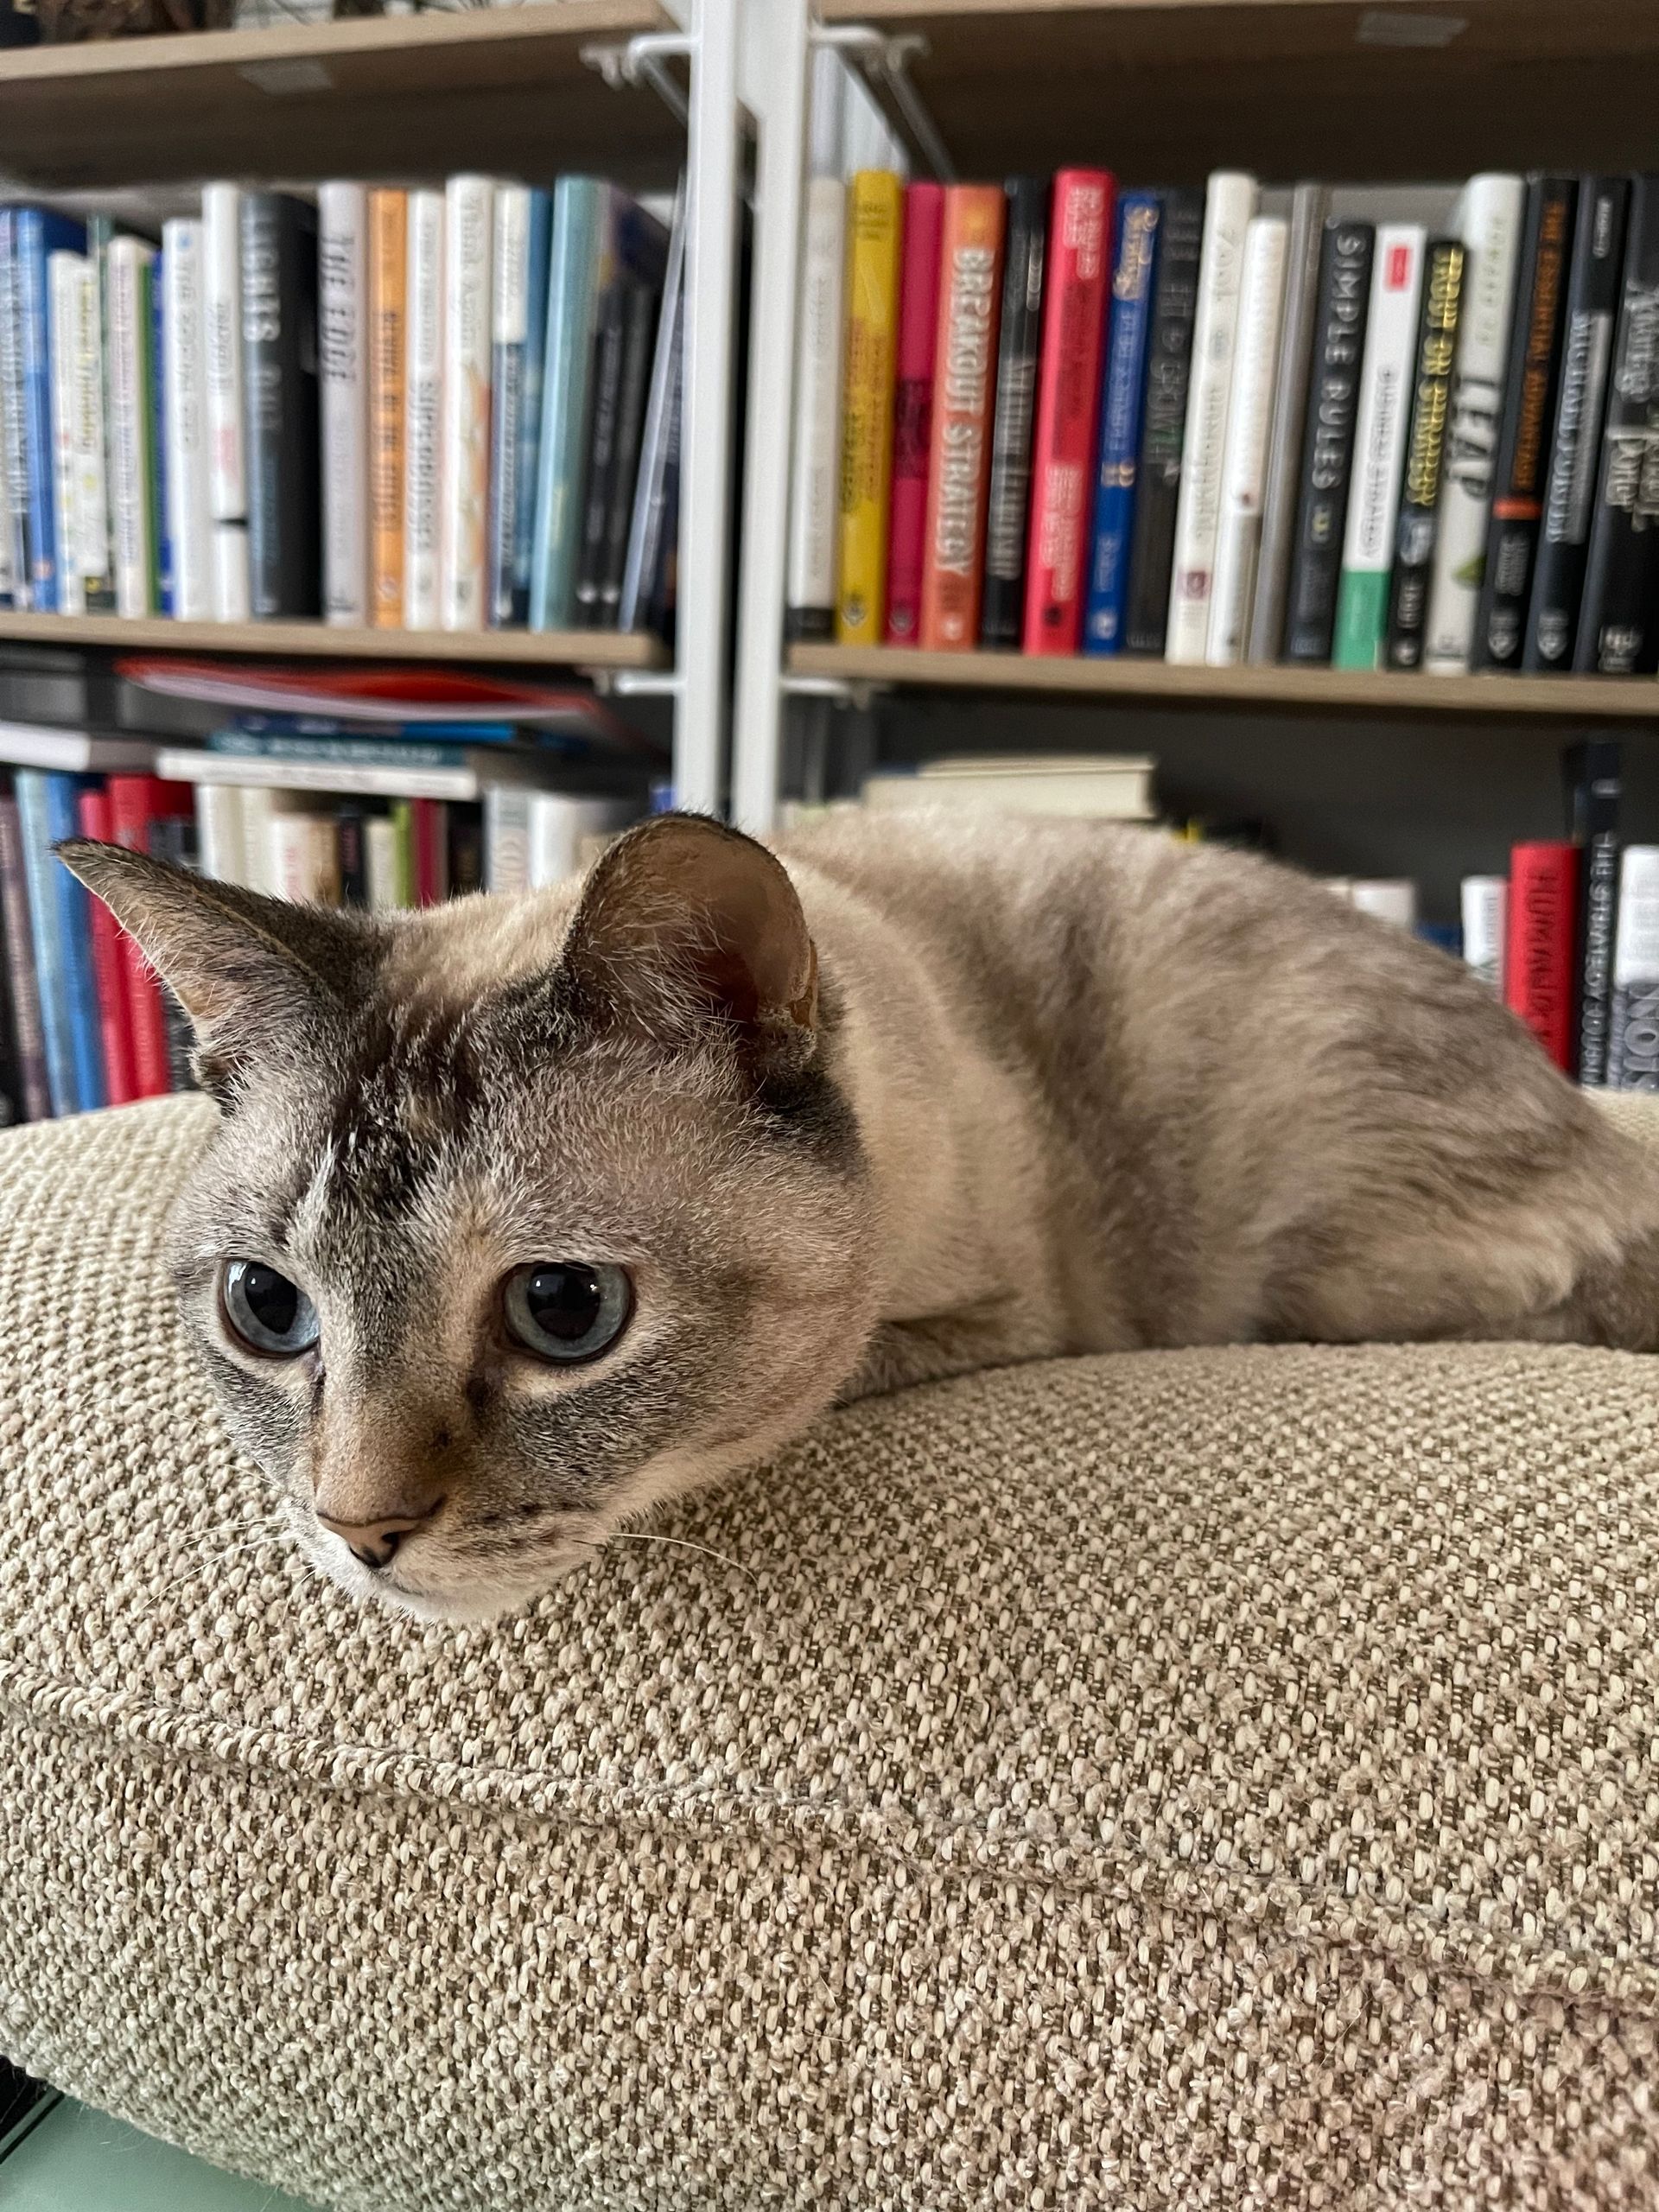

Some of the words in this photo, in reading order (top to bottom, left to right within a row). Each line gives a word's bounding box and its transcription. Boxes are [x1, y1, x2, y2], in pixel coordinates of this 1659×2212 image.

[241, 210, 281, 342] LIGHTS
[320, 234, 355, 288] THE
[1539, 199, 1567, 241] THE
[320, 302, 356, 382] EDGE
[944, 245, 995, 415] BREAKOUT
[1325, 232, 1367, 366] SIMPLE
[1427, 245, 1464, 328] TROUT
[1421, 333, 1453, 376] ON
[1311, 377, 1351, 490] RULES
[1405, 378, 1448, 505] STRATEGY
[934, 420, 984, 576] STRATEGY
